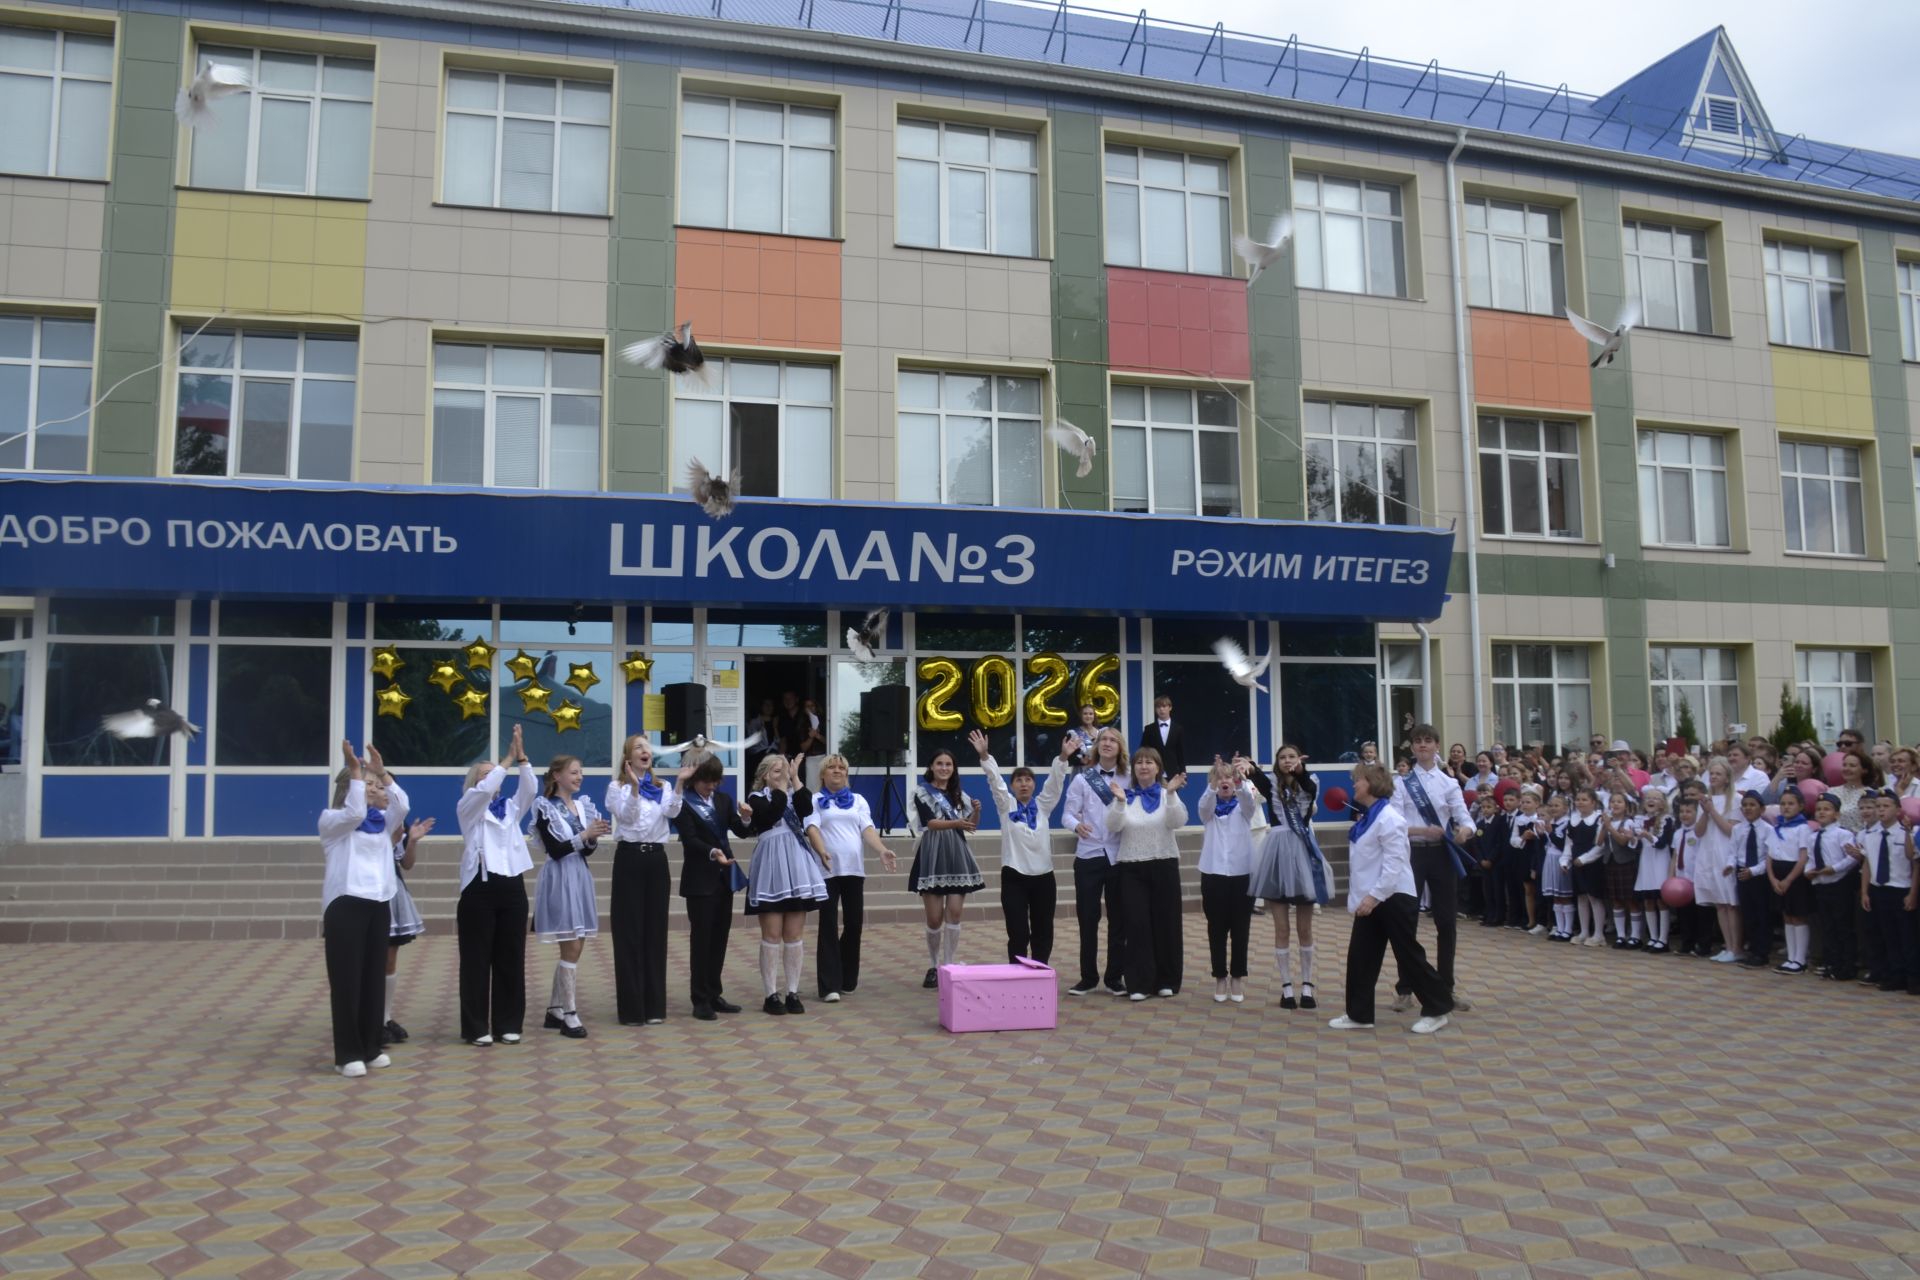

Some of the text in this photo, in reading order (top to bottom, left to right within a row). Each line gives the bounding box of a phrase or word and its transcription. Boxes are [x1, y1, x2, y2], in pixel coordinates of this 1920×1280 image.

[0, 514, 458, 553] ДОБРО ПОЖАЛОВАТЬ
[609, 523, 1036, 585] ШКОЛА №3
[1171, 549, 1429, 585] РӘХИМ ИТЕГЕЗ
[917, 651, 1121, 732] 2026
